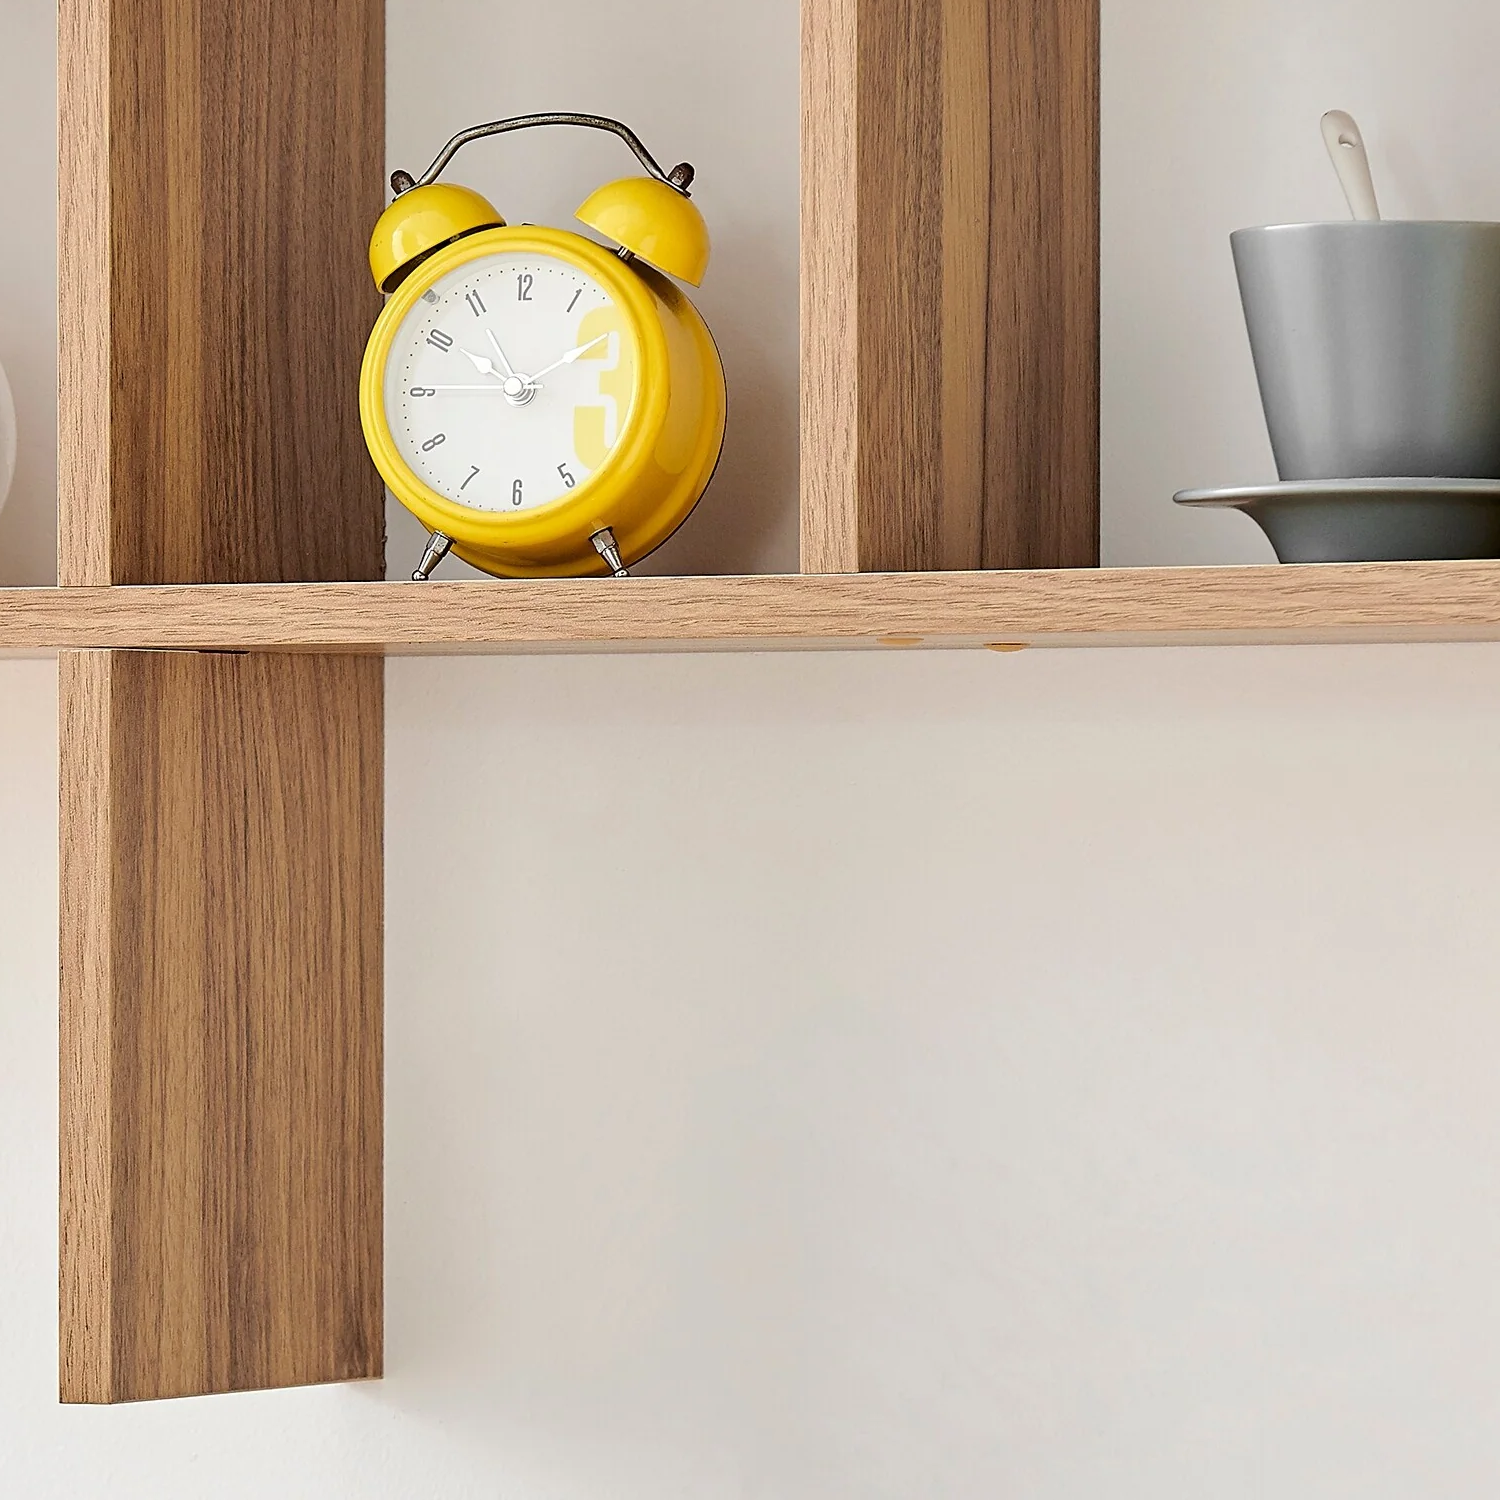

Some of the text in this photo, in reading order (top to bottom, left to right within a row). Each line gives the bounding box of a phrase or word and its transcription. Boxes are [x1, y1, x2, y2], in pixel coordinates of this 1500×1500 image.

[516, 273, 534, 302] 12
[465, 288, 488, 319] 11
[566, 288, 583, 314] 1
[425, 328, 454, 353] 10
[409, 386, 436, 398] 9
[421, 432, 447, 453] 8
[459, 465, 481, 491] 7
[556, 462, 576, 489] 5
[512, 478, 523, 506] 6
